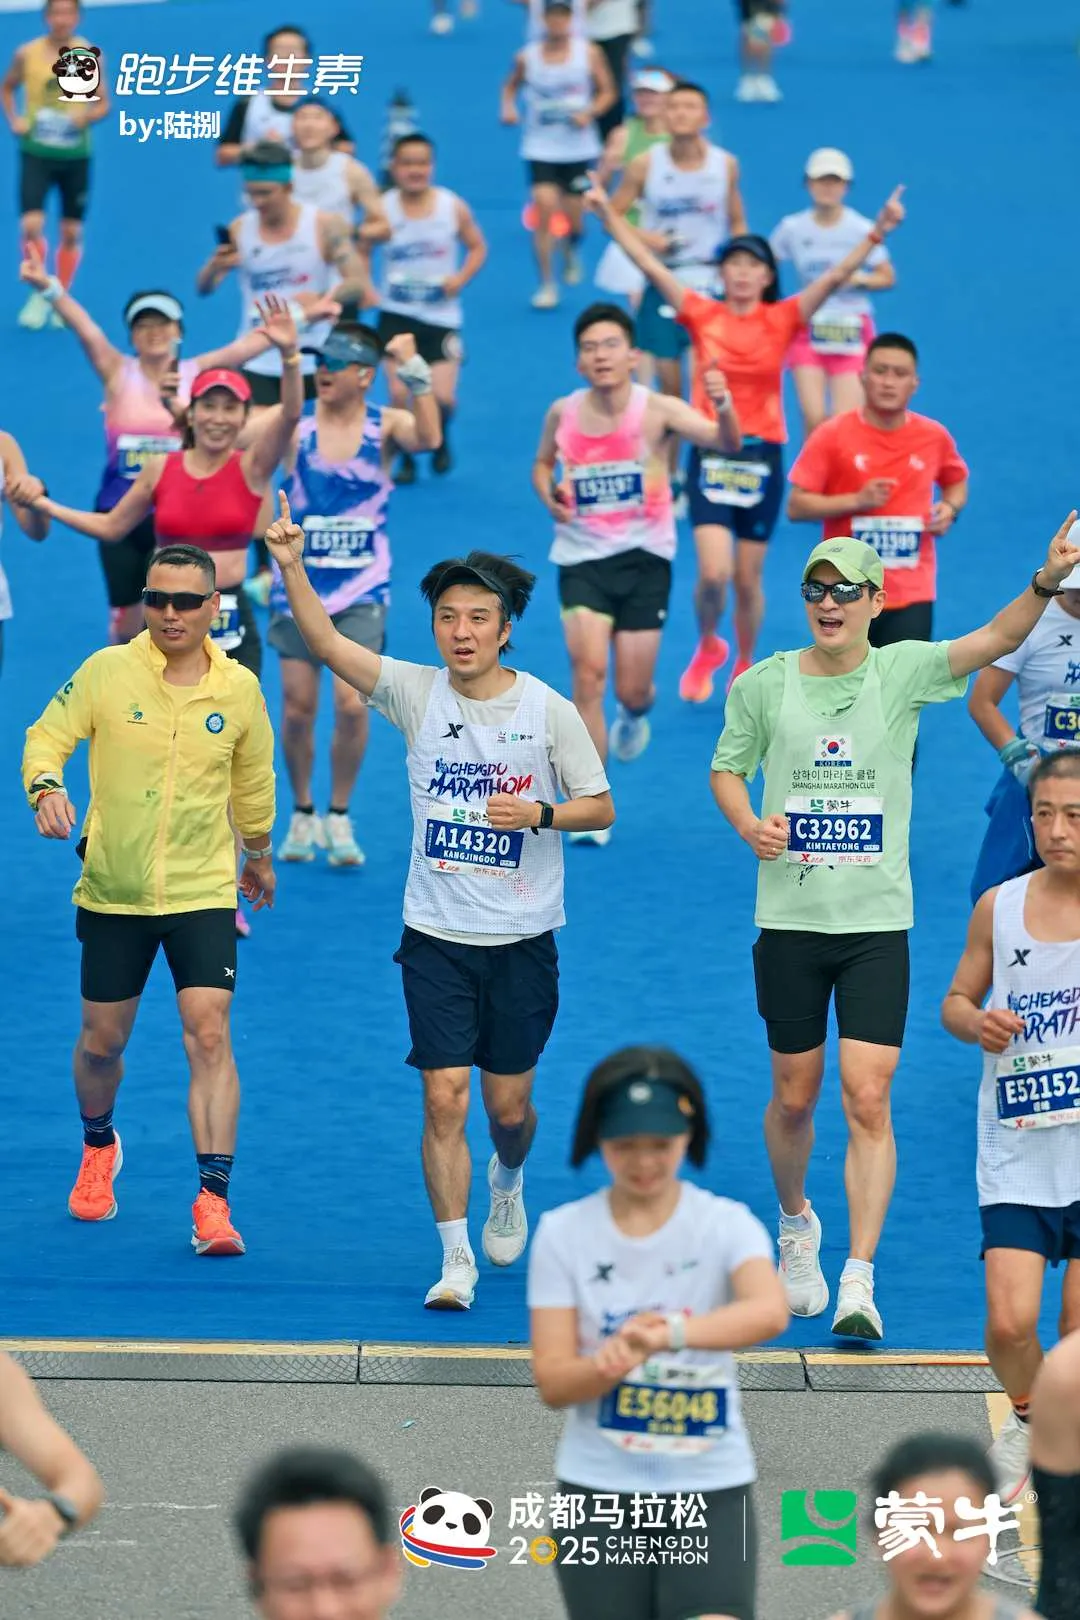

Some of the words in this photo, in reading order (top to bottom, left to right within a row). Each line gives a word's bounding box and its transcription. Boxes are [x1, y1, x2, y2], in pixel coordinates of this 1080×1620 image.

[1055, 711, 1080, 730] C3
[450, 762, 508, 776] CHENGDU
[792, 769, 820, 780] 상하이
[427, 774, 534, 802] MARATHON
[795, 818, 872, 840] C32962
[434, 826, 511, 856] A14320
[805, 842, 860, 850] KIMTAEYONG
[443, 850, 496, 864] KANGJINGOO
[1018, 987, 1080, 1011] CHENGD
[1005, 1070, 1080, 1105] E52152
